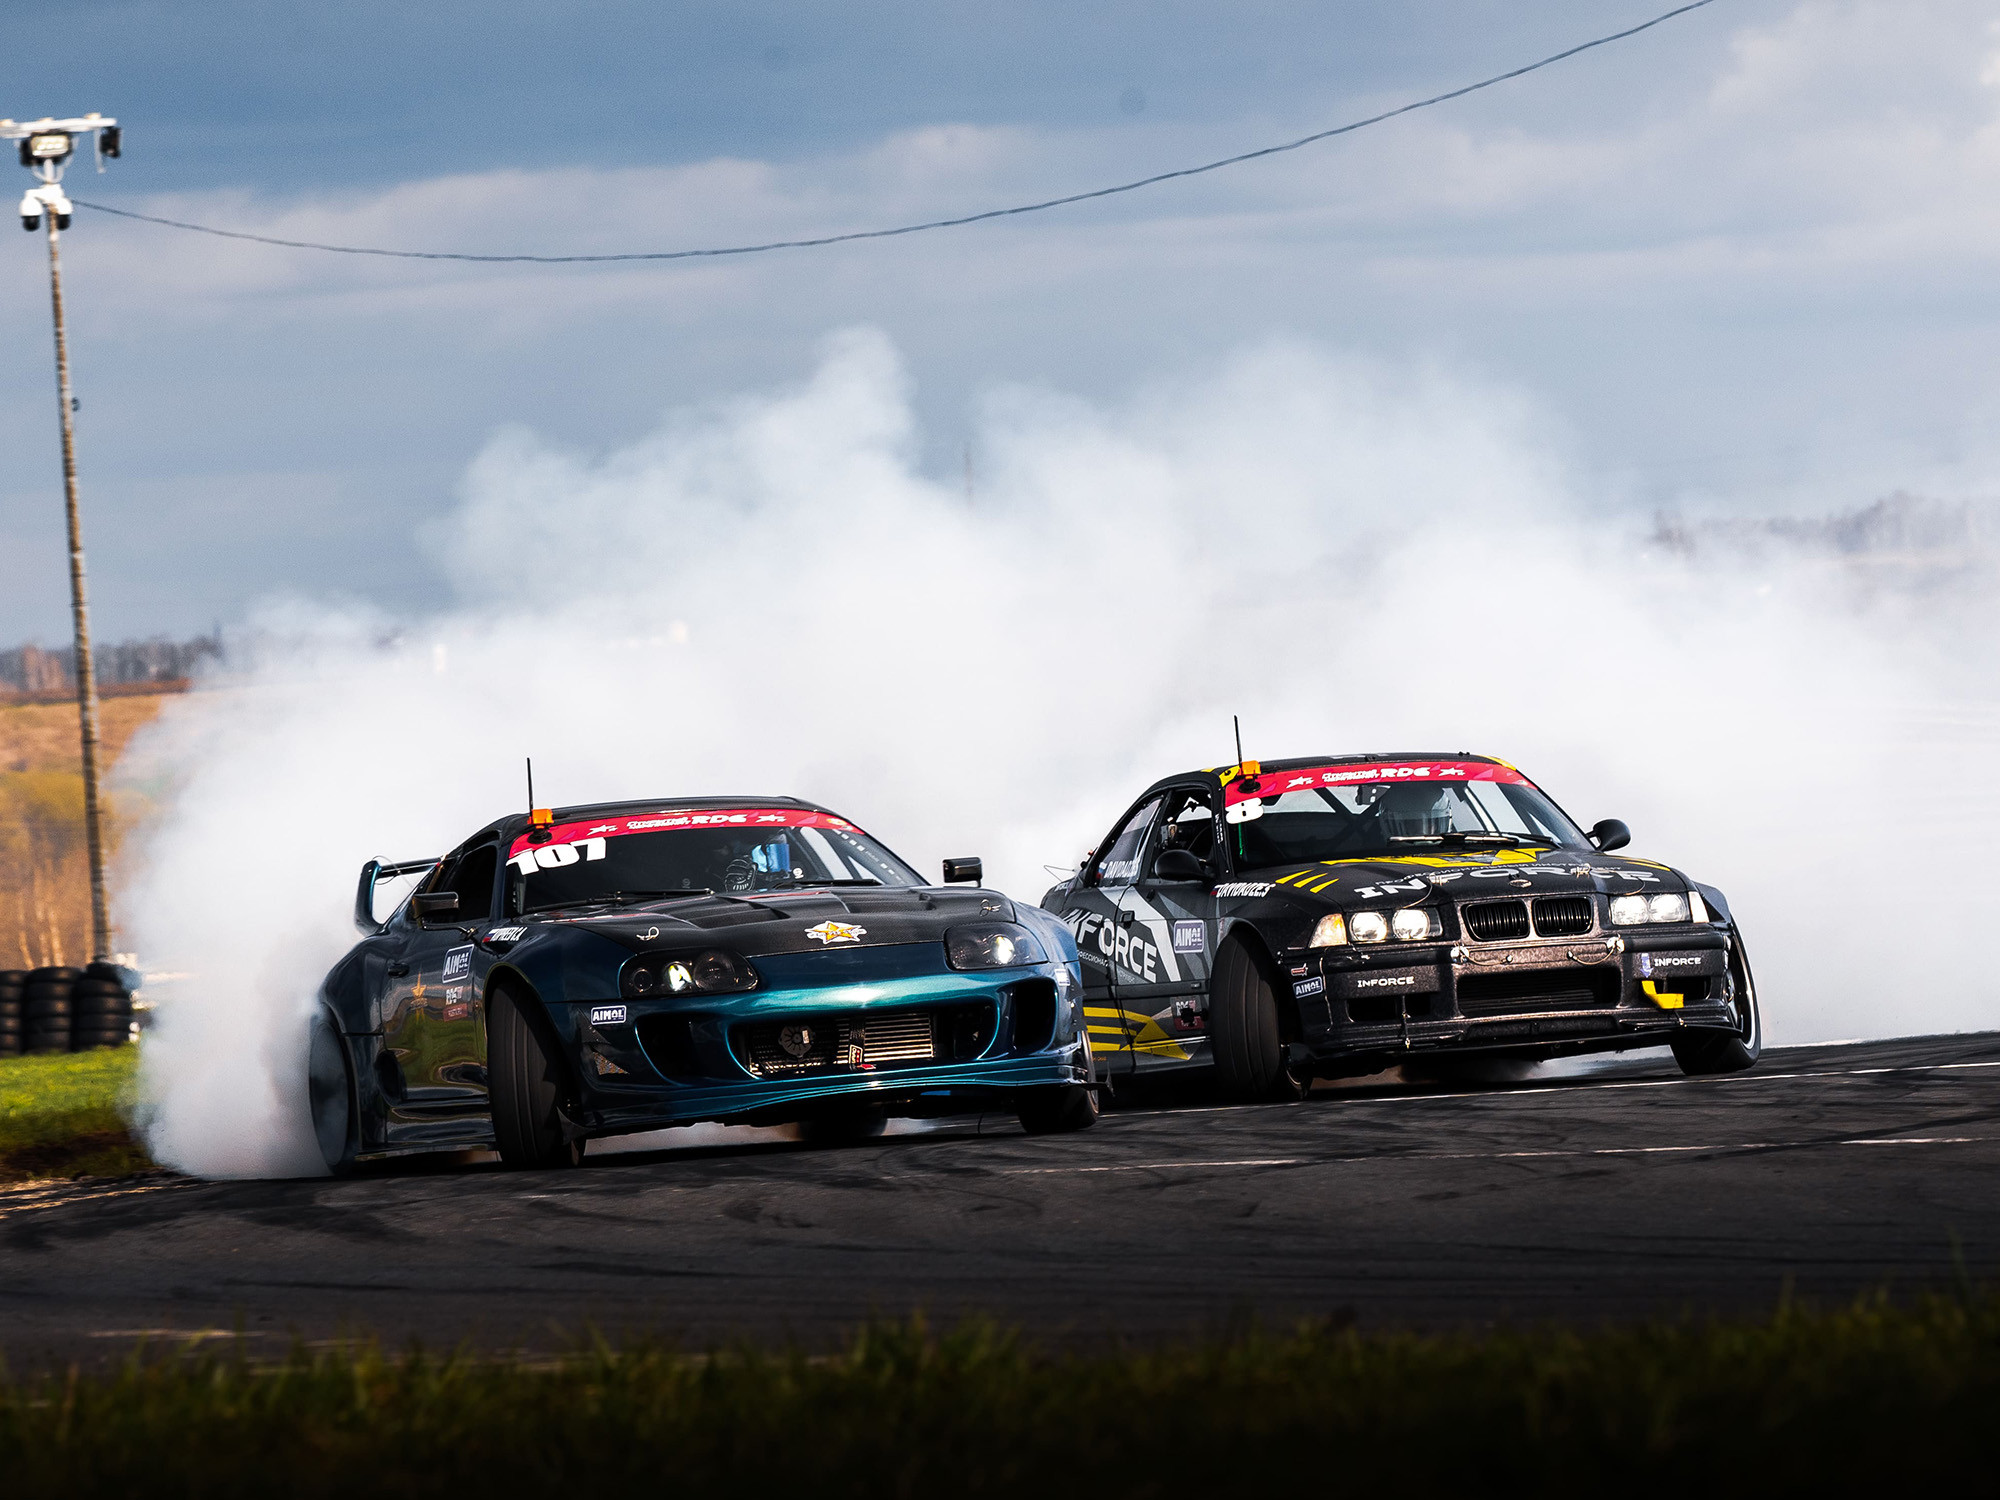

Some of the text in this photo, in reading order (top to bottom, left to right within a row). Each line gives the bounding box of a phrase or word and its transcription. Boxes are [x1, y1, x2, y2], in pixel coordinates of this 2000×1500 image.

[1225, 797, 1264, 824] 8
[505, 837, 607, 876] 107
[1654, 957, 1702, 967] INFORCE
[1295, 980, 1321, 996] AIMOL
[1357, 976, 1414, 988] INFORCE
[591, 1007, 625, 1022] AIMOL
